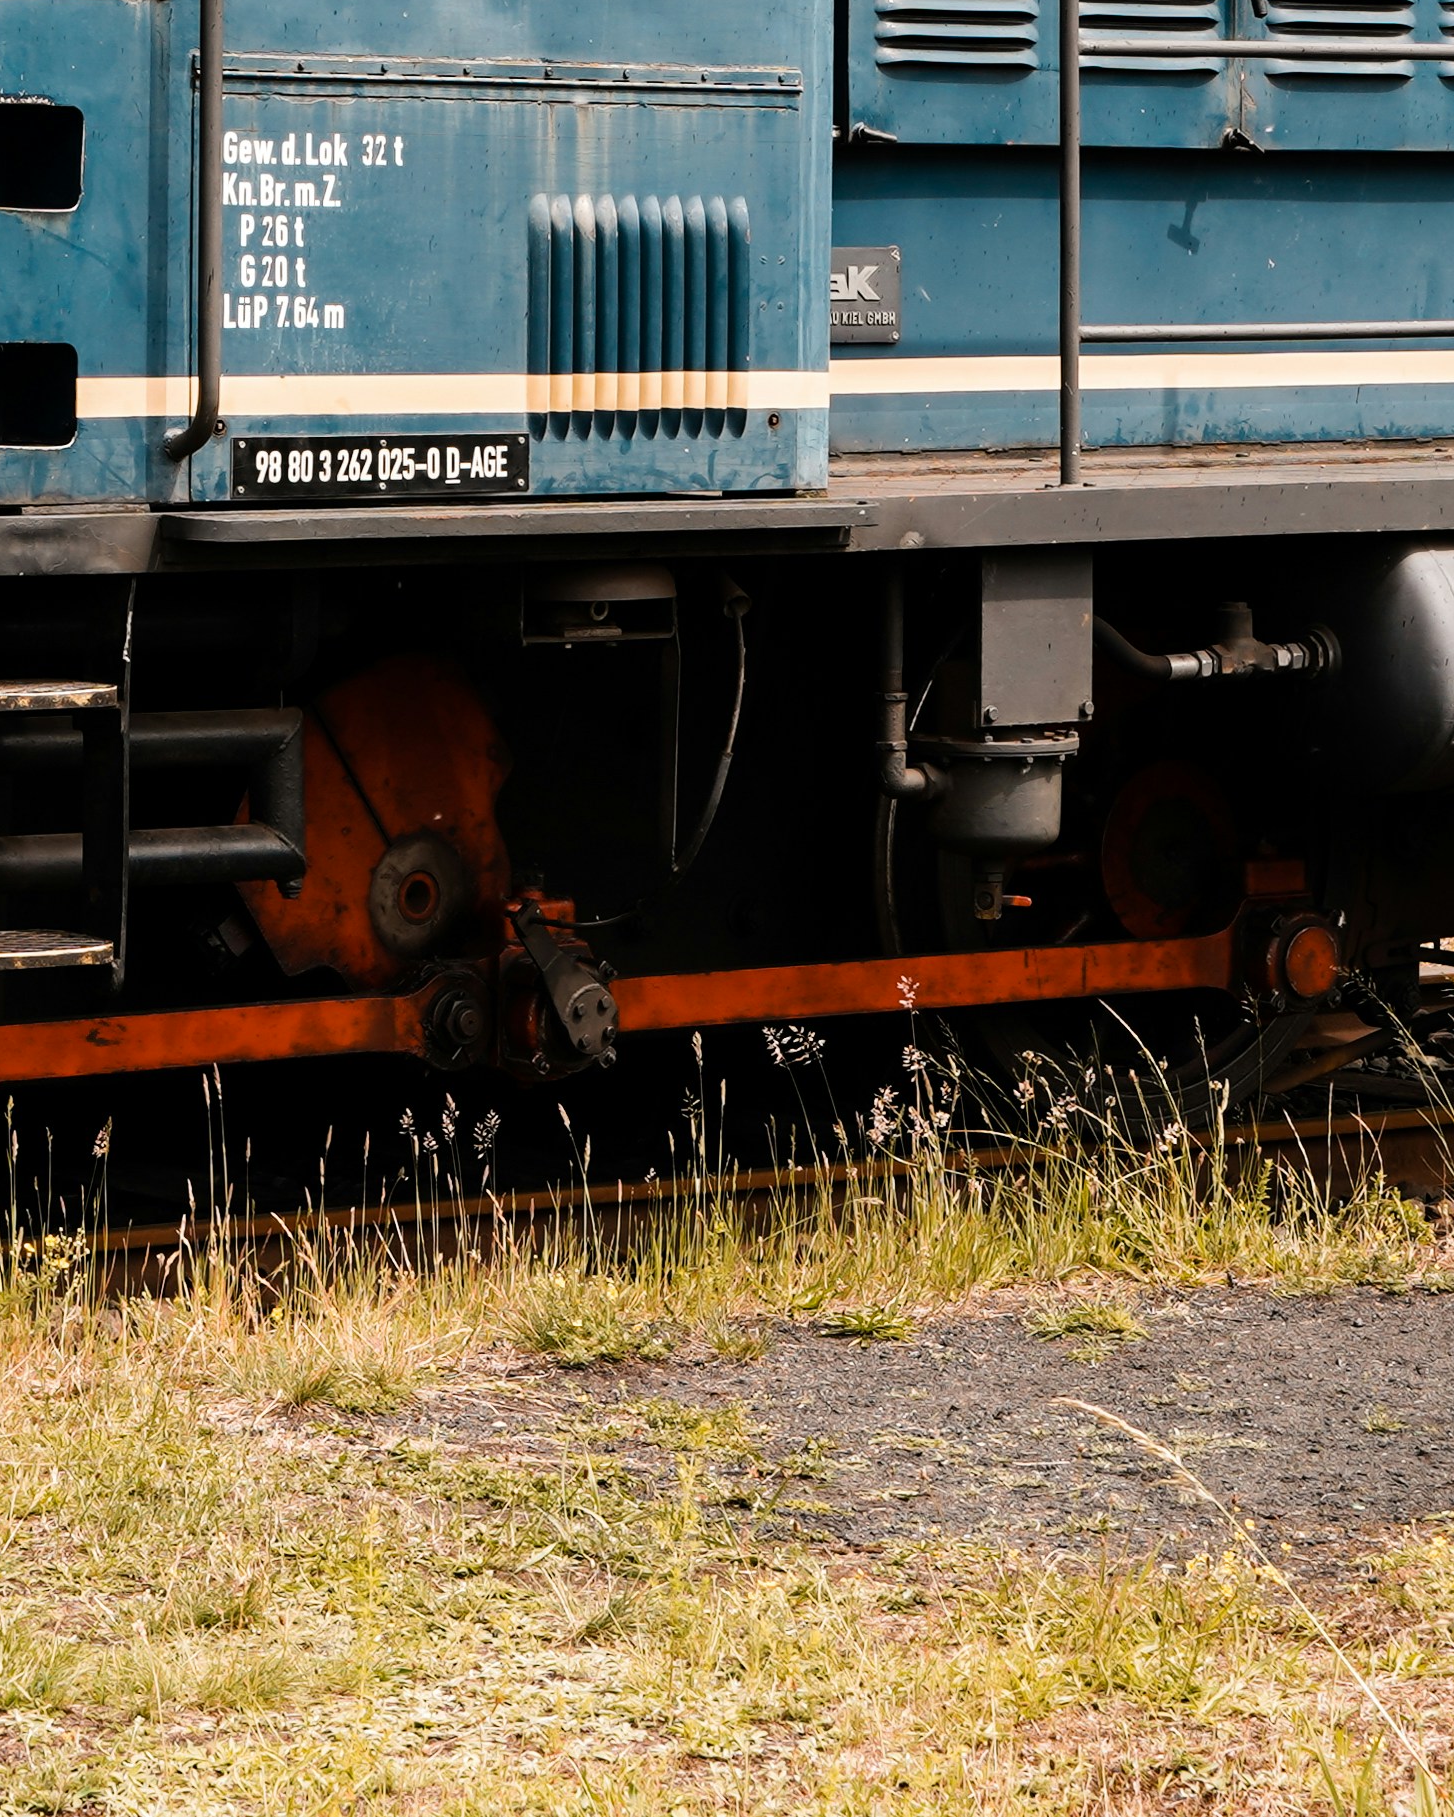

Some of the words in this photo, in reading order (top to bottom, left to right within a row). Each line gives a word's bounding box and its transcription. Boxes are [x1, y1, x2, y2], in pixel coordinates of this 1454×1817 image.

[223, 131, 277, 165] Gew.
[281, 133, 301, 166] d.
[305, 132, 348, 166] Lok
[362, 134, 387, 166] 32
[394, 136, 404, 167] t
[240, 213, 255, 247] P
[261, 214, 289, 247] 26
[294, 216, 304, 248] t
[240, 254, 256, 288] G
[261, 255, 288, 287] 20
[295, 257, 306, 288] t
[830, 265, 881, 301] aK
[223, 293, 269, 329] LüP
[324, 304, 345, 329] m
[842, 311, 863, 325] KIEL
[867, 311, 896, 325] GMBH
[255, 450, 282, 483] 98
[287, 449, 314, 483] 80
[318, 449, 332, 482] 3
[336, 448, 372, 482] 262
[378, 447, 440, 480] 025-0
[445, 445, 508, 484] D-AGE
